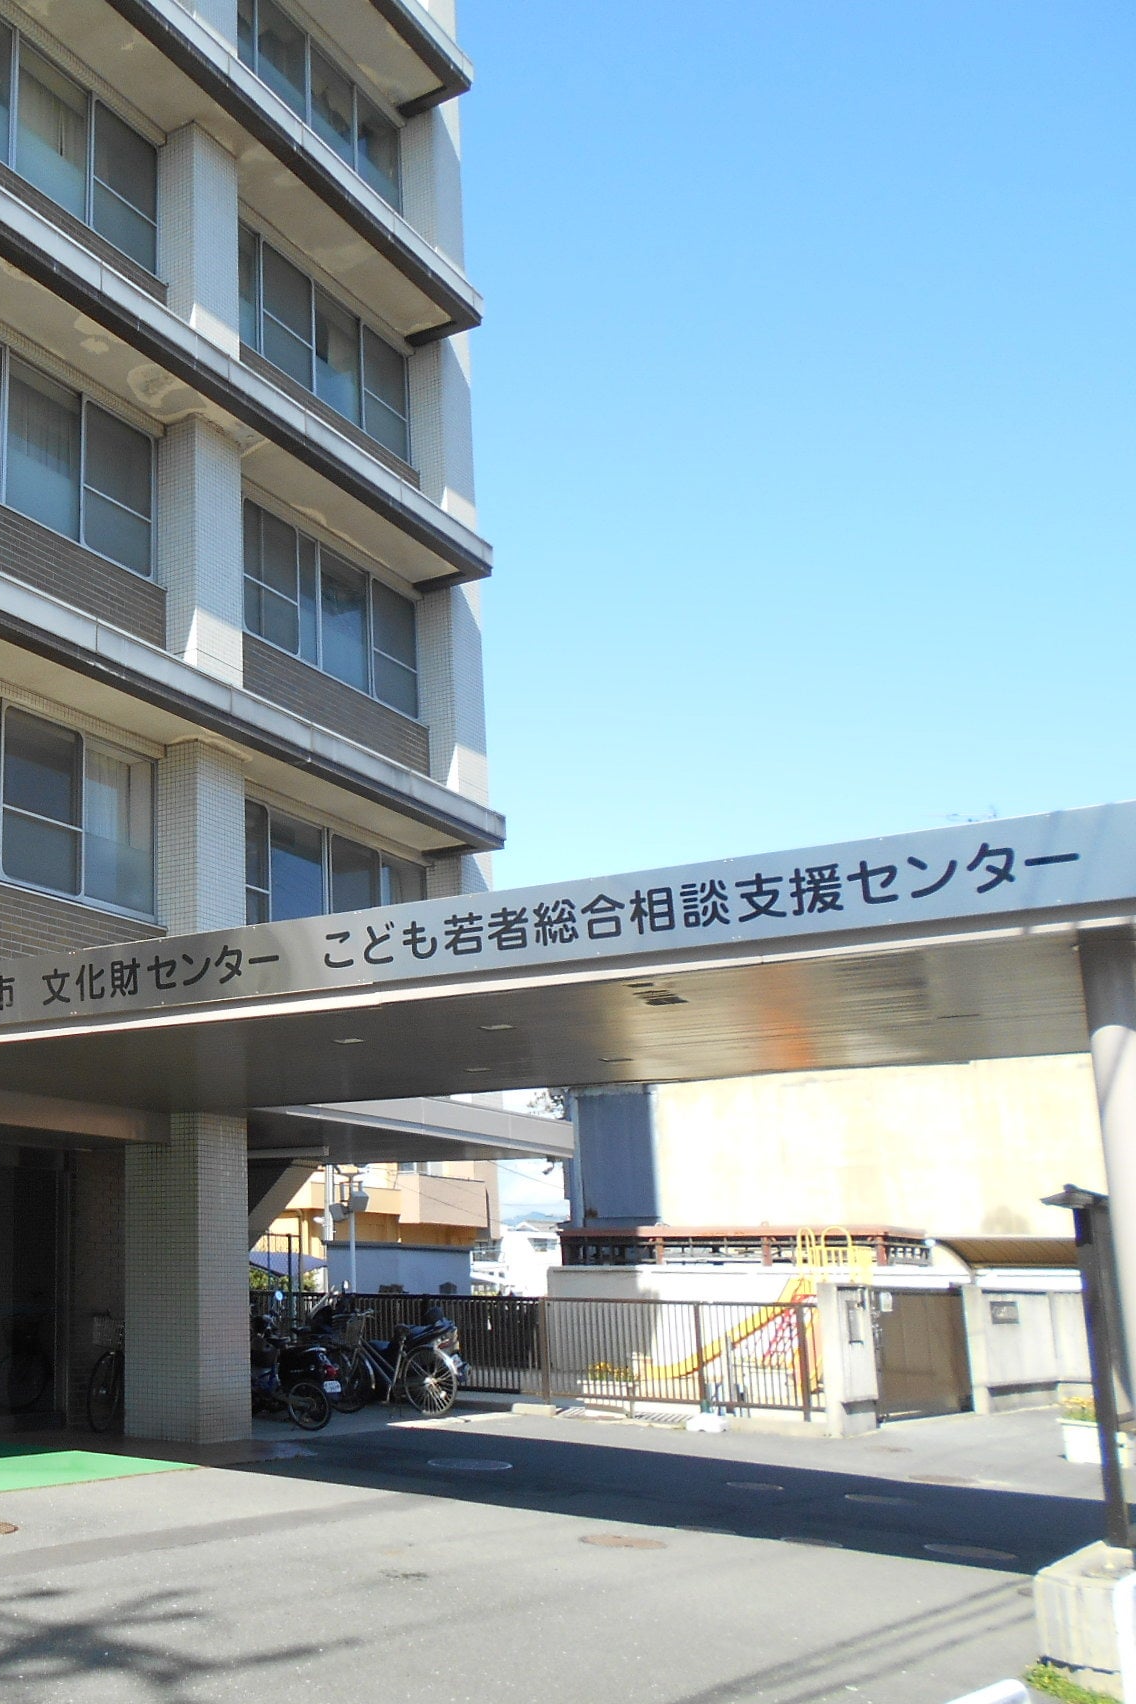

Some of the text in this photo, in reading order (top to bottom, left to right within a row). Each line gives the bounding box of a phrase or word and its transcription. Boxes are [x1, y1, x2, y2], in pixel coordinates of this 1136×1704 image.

[43, 945, 280, 1006] 文化財センター
[323, 843, 1081, 970] こども若者総合相談支援センター
